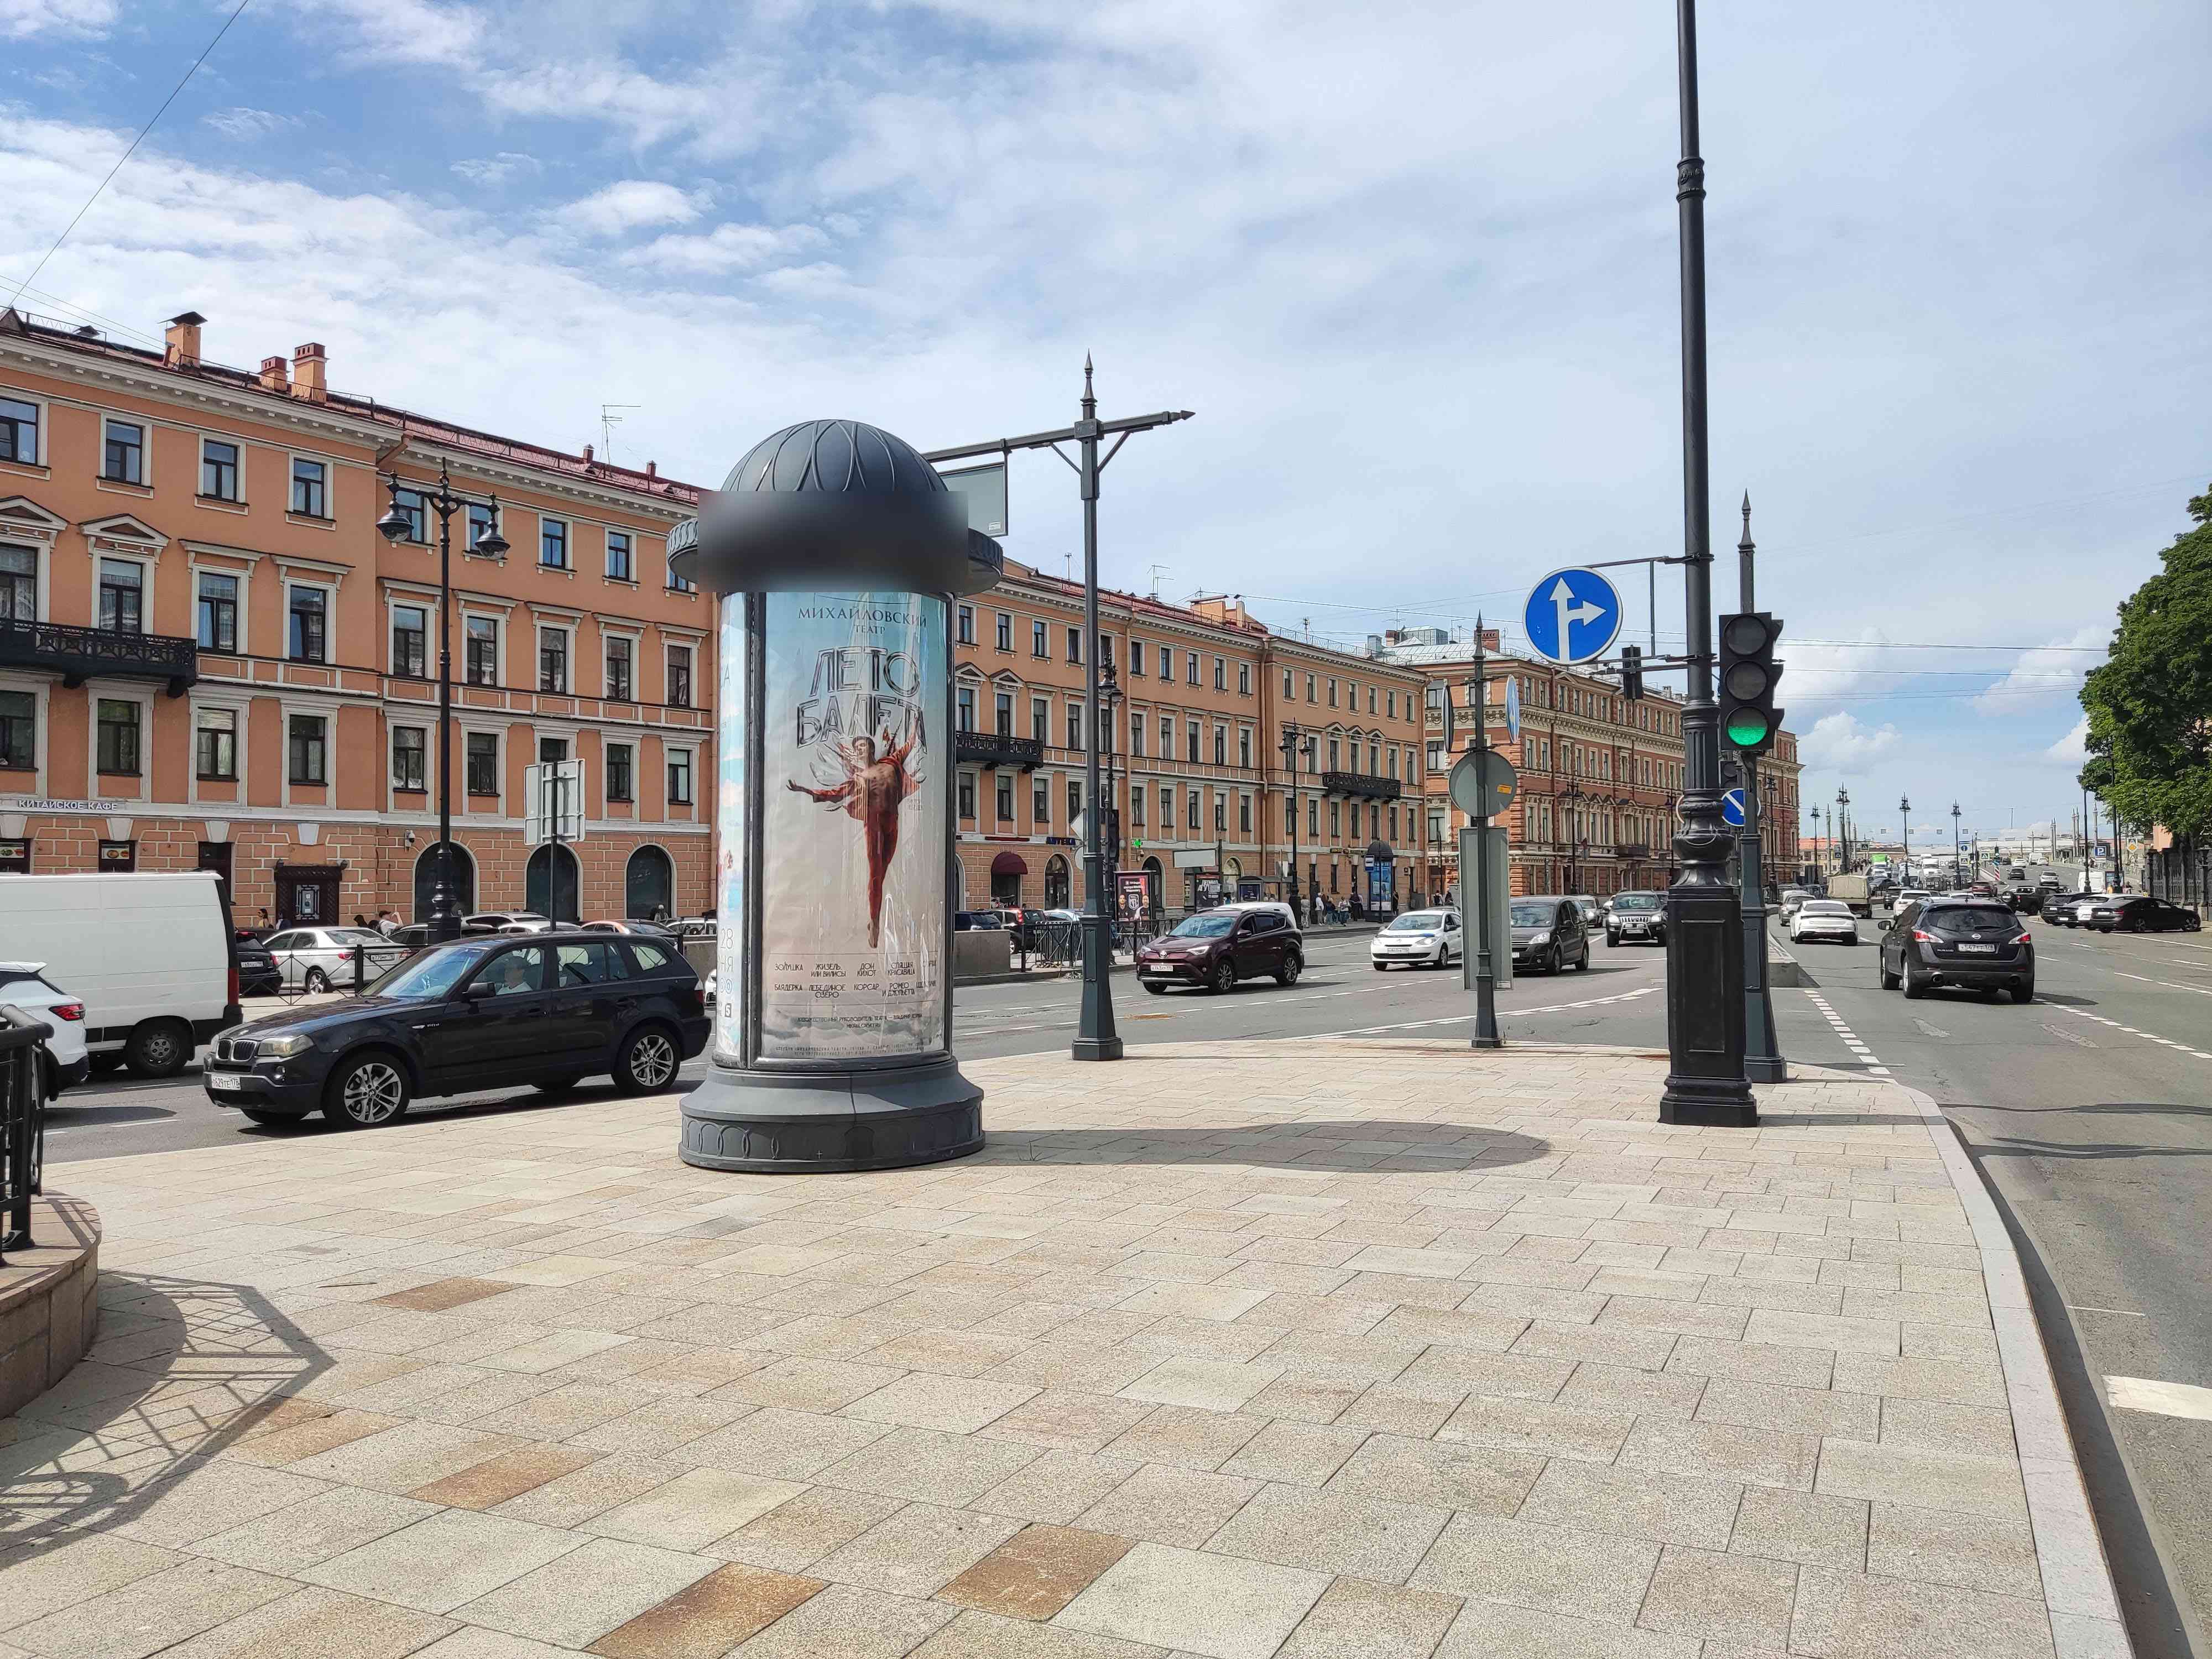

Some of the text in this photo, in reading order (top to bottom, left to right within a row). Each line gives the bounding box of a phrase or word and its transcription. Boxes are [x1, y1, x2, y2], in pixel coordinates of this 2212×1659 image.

[799, 606, 927, 627] МИХАЙЛОВСКИЙ
[853, 624, 885, 634] ТЕАТР
[810, 645, 920, 698] ЛЕТО
[797, 693, 928, 753] БАЛЕТА
[19, 800, 118, 810] КИТАЙСКОЕ КАФЕ
[774, 962, 804, 971] ЗОЛУШКА
[889, 982, 909, 990] РОМЕО
